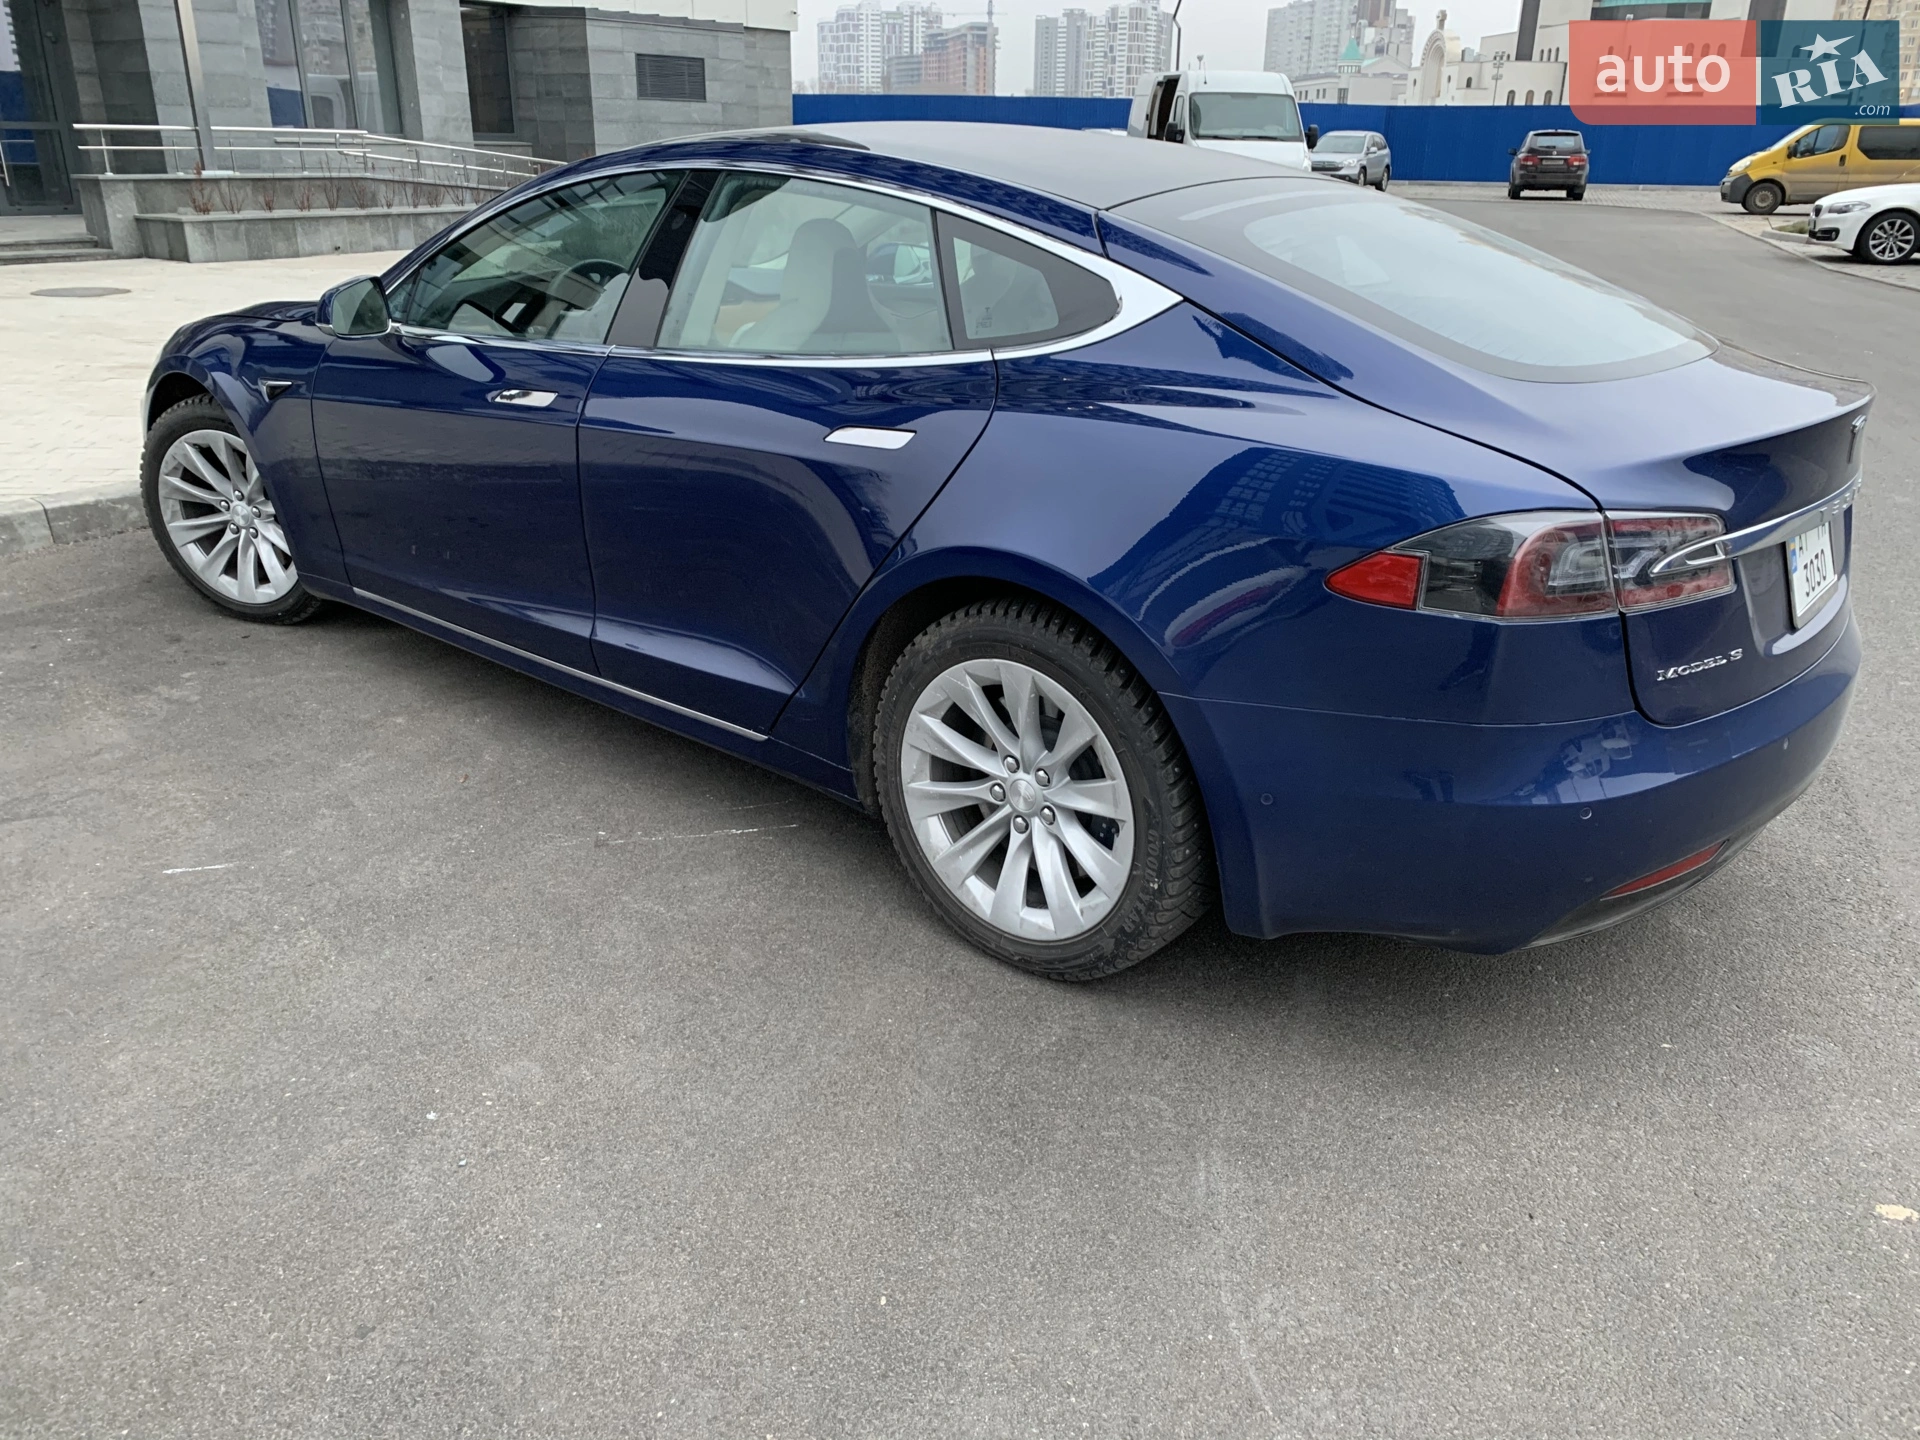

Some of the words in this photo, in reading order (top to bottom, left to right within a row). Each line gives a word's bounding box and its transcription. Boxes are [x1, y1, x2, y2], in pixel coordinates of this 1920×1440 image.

[1803, 548, 1827, 598] 3030
[1656, 655, 1728, 682] MODEL
[1728, 648, 1744, 662] S
